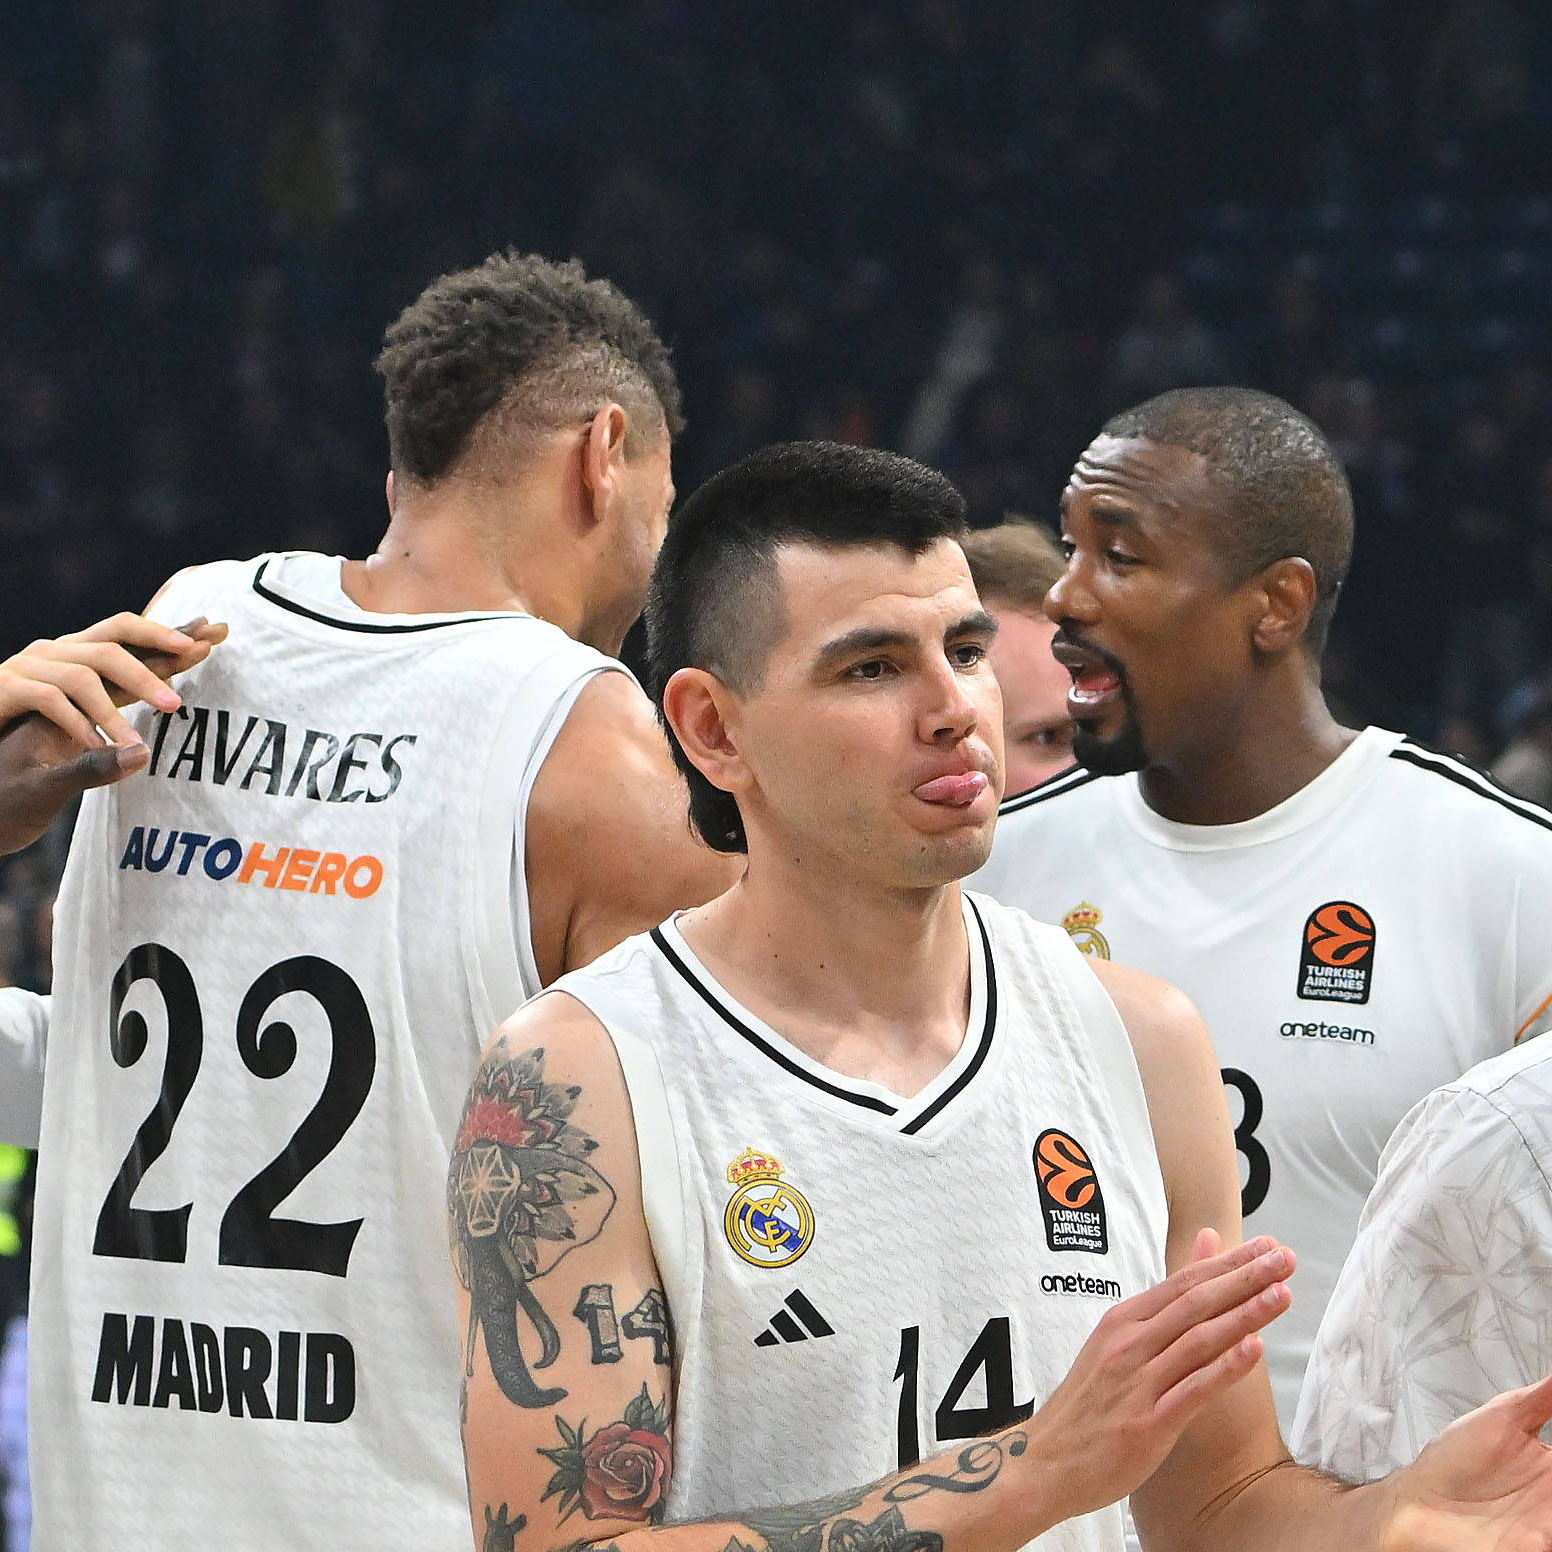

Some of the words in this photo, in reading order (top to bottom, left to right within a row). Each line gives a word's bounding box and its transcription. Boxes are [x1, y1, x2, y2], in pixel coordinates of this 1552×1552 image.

[148, 703, 418, 804] TAVARES
[119, 825, 385, 900] AUTOHERO
[1304, 976, 1365, 991] AIRLINES
[1306, 965, 1366, 980] TURKISH
[92, 942, 377, 1278] 22
[1049, 1209, 1100, 1225] TURKISH
[1052, 1223, 1102, 1238] AIRLINES
[1052, 1234, 1103, 1250] EuroLeague
[1041, 1272, 1122, 1298] oneteam
[91, 1312, 356, 1424] MADRID
[892, 1316, 1035, 1474] 14
